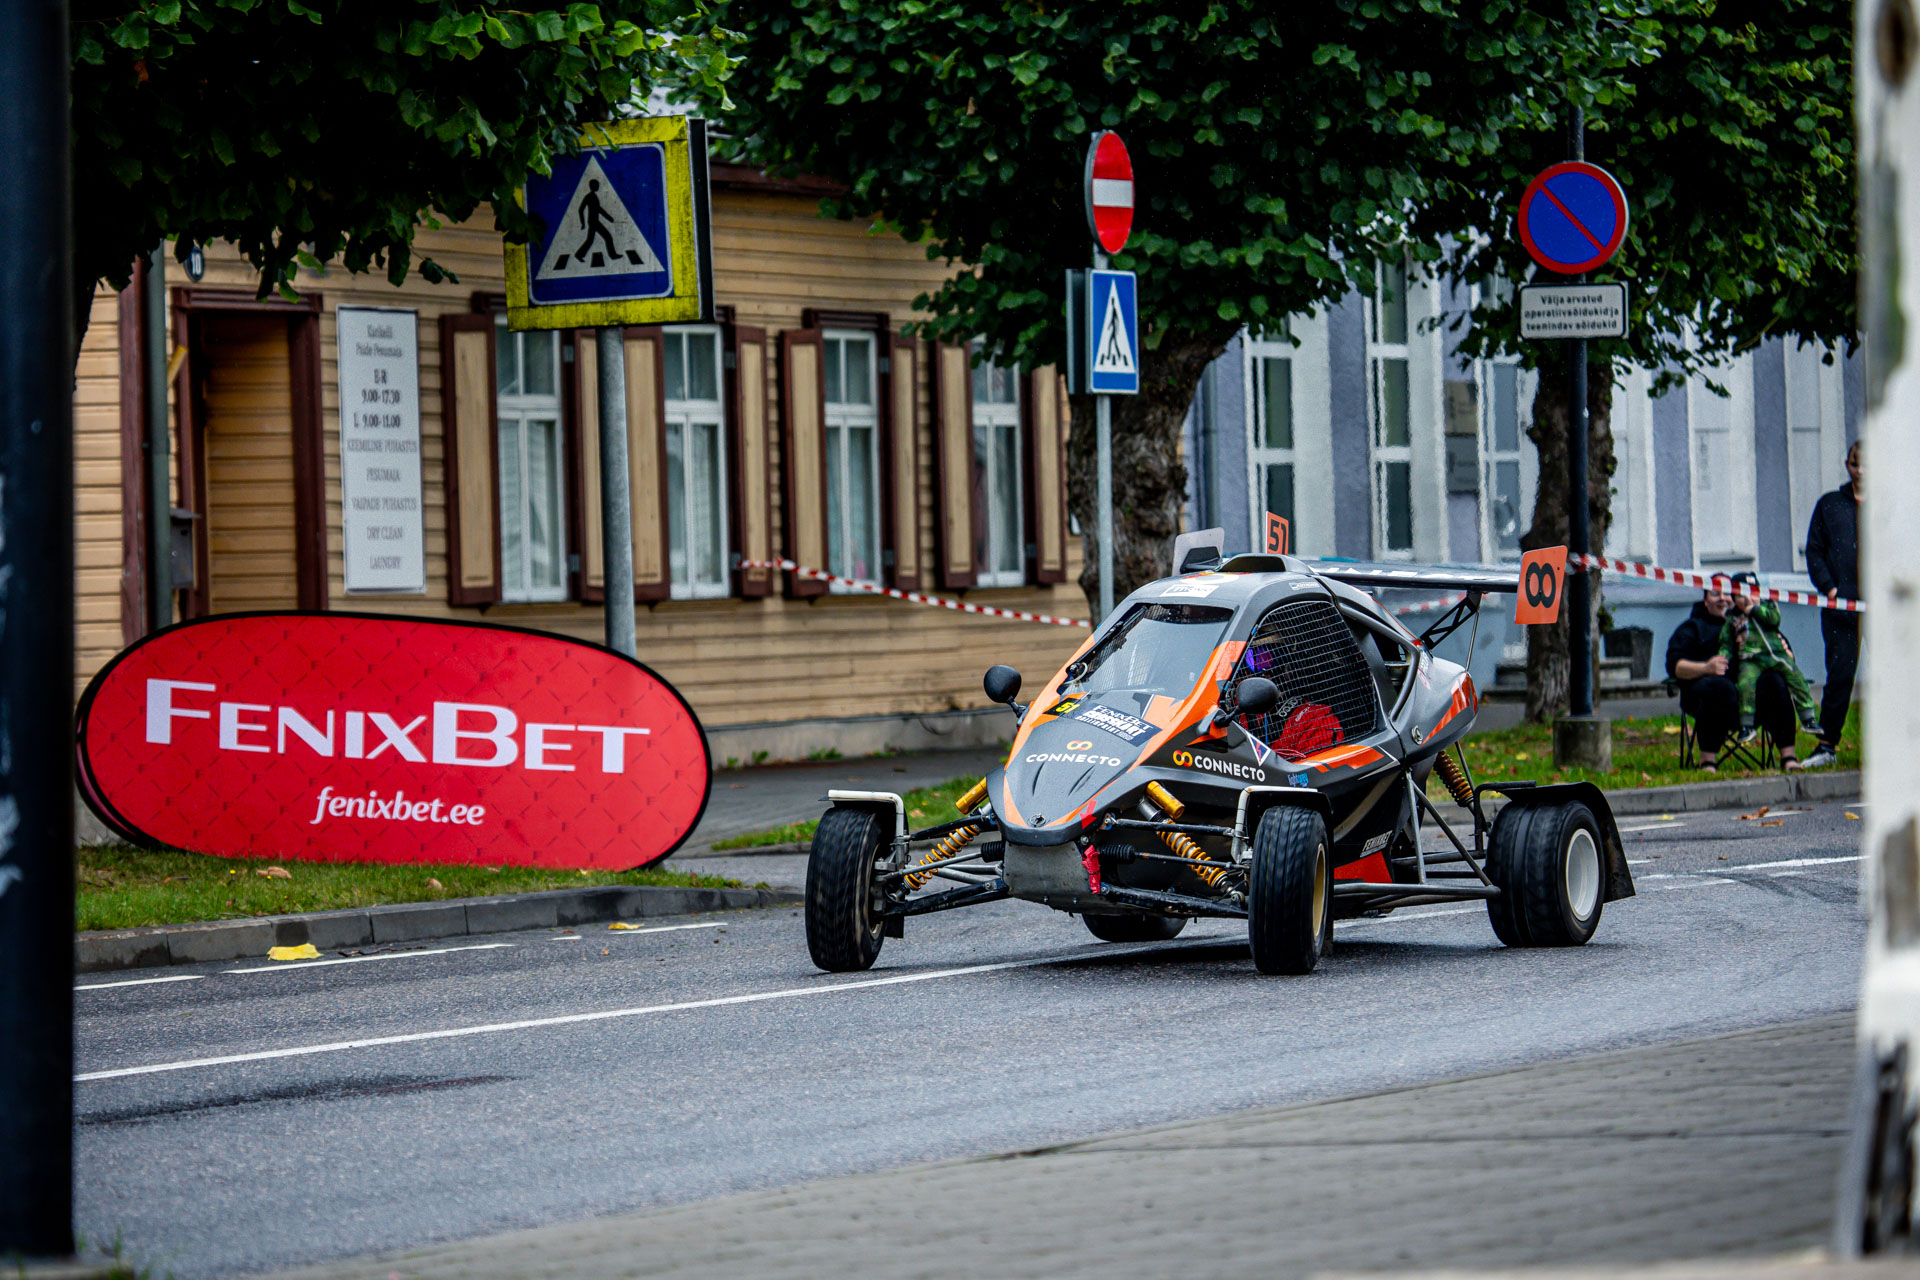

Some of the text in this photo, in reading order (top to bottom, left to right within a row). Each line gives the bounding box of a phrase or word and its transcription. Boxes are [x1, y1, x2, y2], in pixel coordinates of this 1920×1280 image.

[1540, 294, 1603, 306] Välja arvatud
[1524, 306, 1619, 319] operatiivsõidukid ja
[1575, 319, 1617, 330] sõidukid
[366, 525, 403, 541] DRY CLEAN
[369, 555, 402, 570] LAUNDRY
[1026, 752, 1121, 767] CONNECTO
[1194, 755, 1266, 783] CONNECTO
[310, 786, 485, 826] fenixbet.ee
